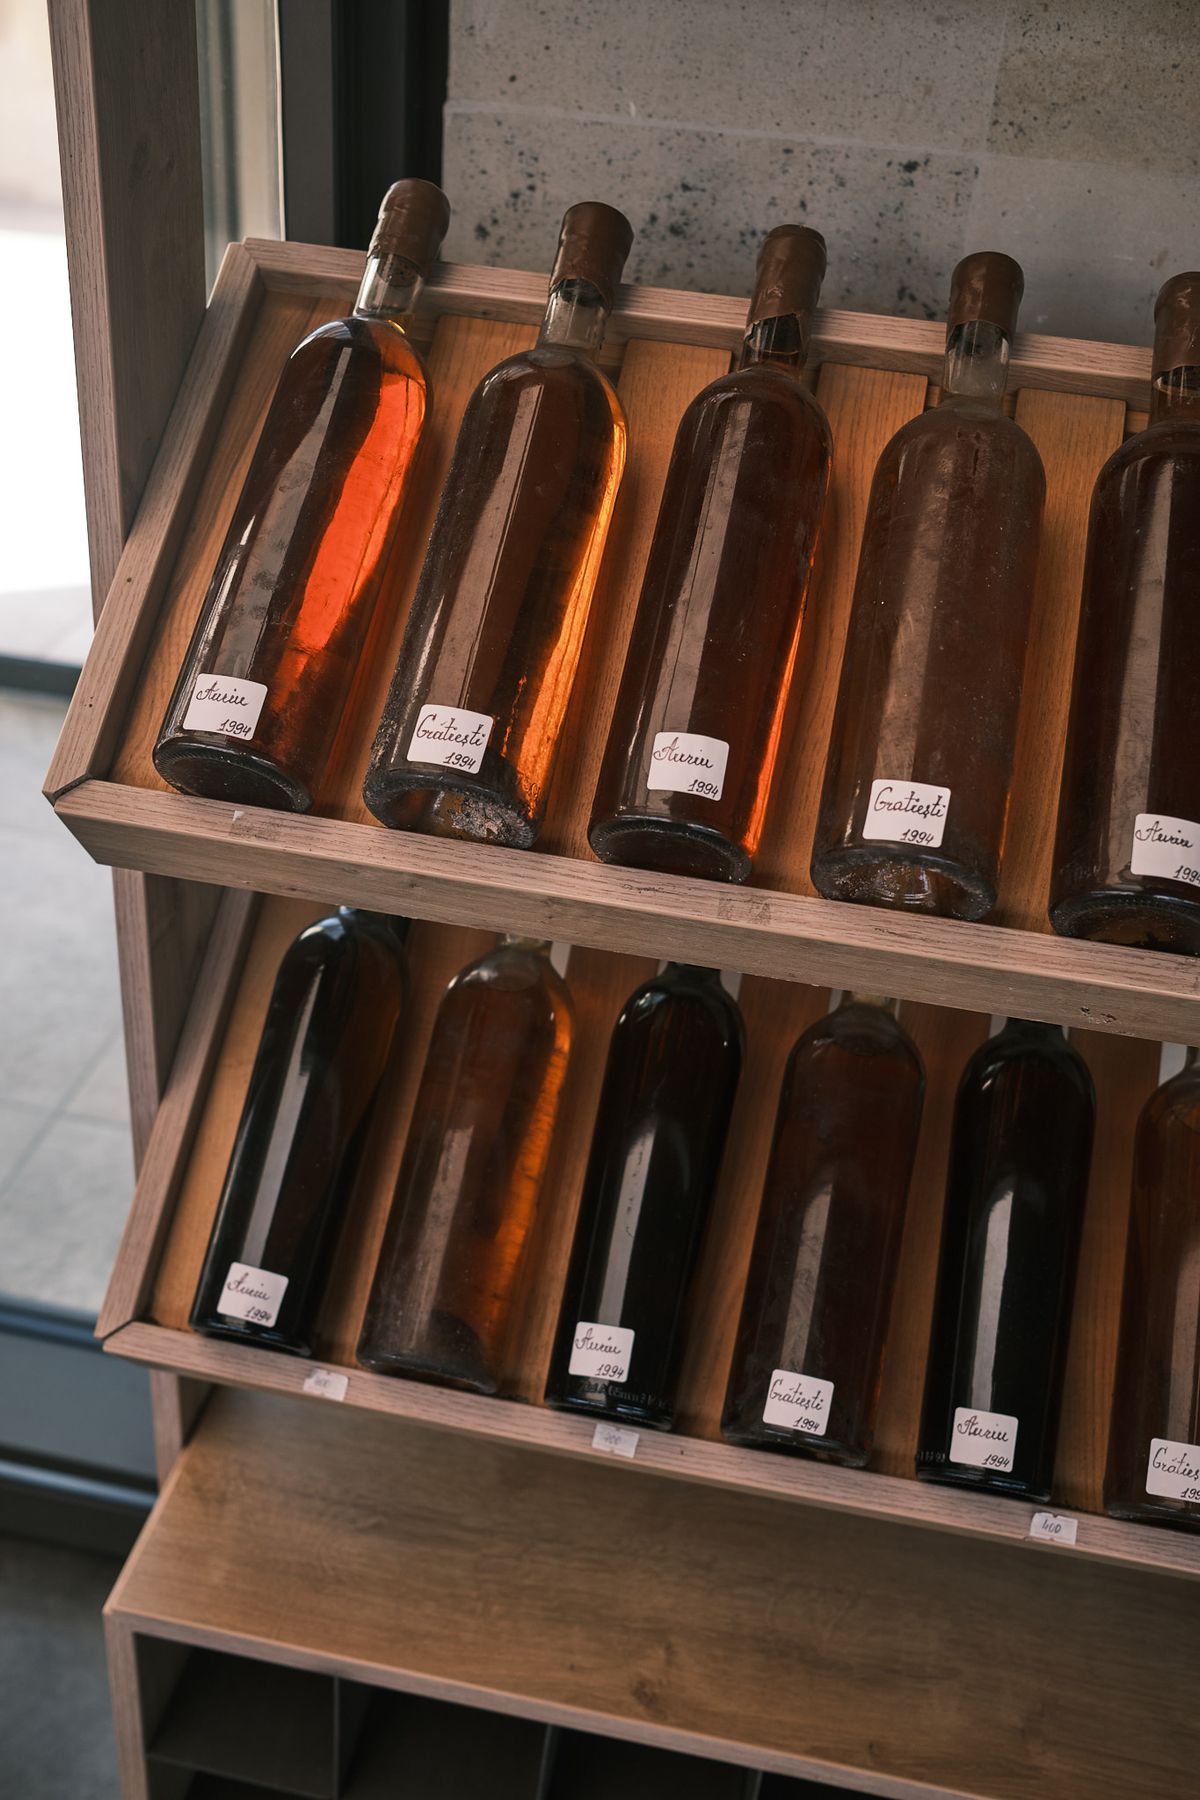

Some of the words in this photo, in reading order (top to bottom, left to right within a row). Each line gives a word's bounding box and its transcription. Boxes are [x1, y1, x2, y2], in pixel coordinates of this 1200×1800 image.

[196, 681, 249, 706] Auriu
[216, 719, 252, 737] 1994
[443, 752, 476, 769] 1994
[653, 737, 713, 768] Auriu
[687, 779, 719, 798] 1994
[899, 829, 934, 844] 1994
[1135, 820, 1193, 848] Auriu
[244, 1306, 272, 1322] 1994
[575, 1327, 621, 1354] Auriu
[595, 1363, 624, 1379] 1994
[792, 1416, 820, 1432] 1994
[957, 1415, 1009, 1442] Auriu
[981, 1454, 1010, 1468] 1994
[1041, 1518, 1062, 1534] 400
